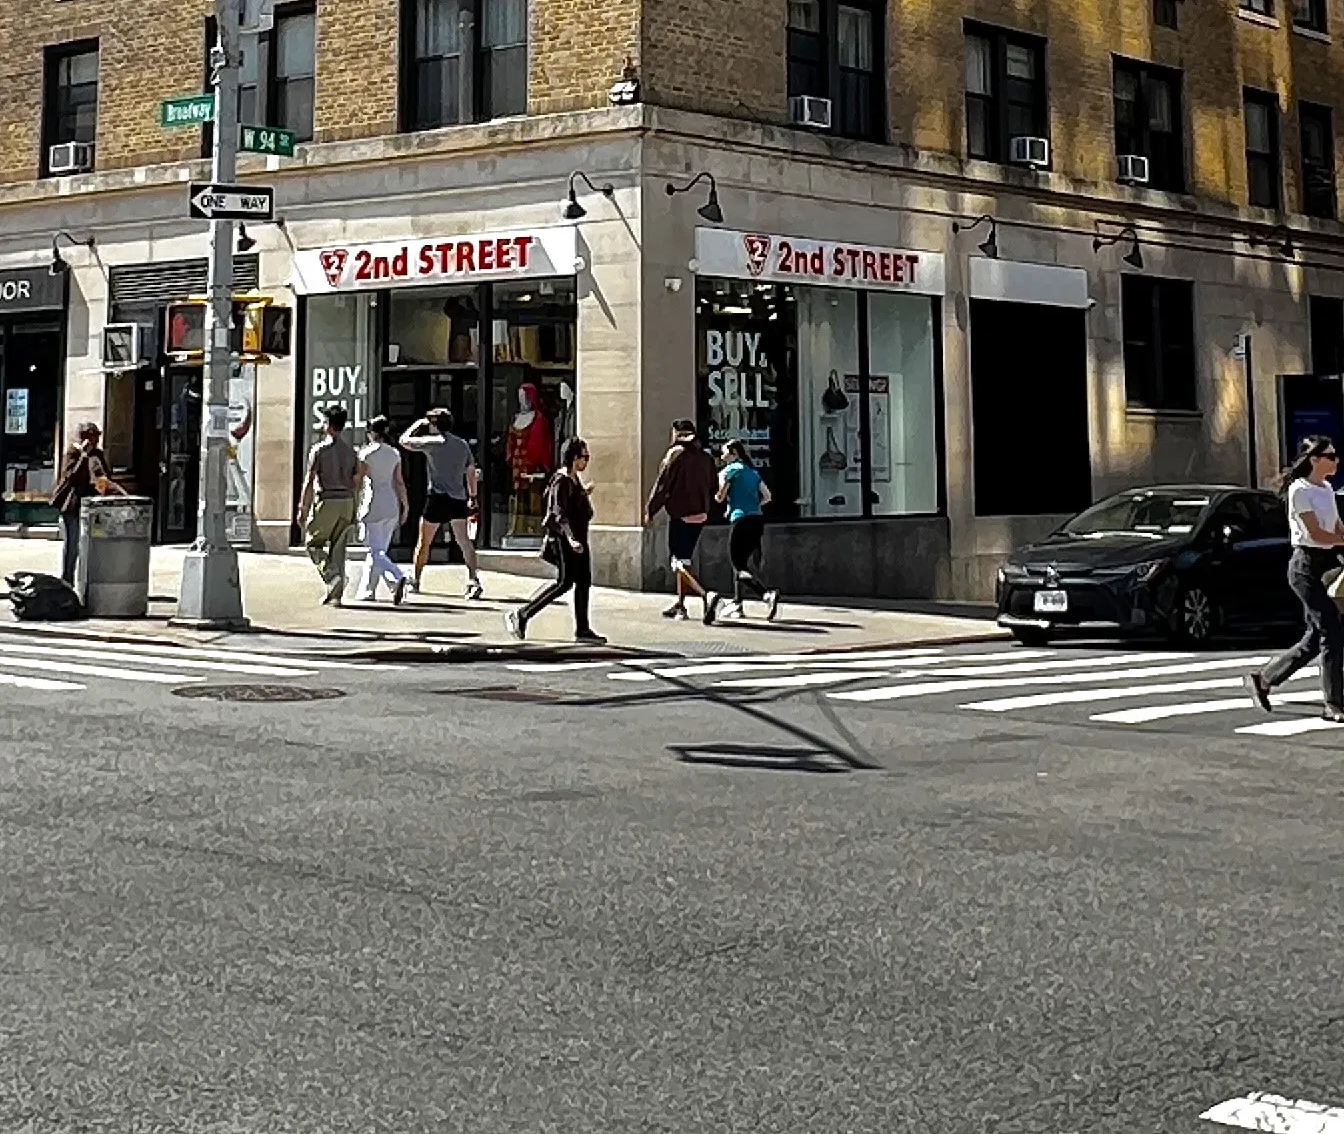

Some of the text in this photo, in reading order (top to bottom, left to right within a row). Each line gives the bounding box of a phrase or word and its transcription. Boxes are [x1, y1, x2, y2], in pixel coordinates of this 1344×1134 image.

[167, 102, 212, 122] Broadway
[244, 128, 256, 149] W
[258, 130, 276, 151] 94
[200, 194, 267, 210] ONE WAY
[355, 246, 408, 281] 2nd
[419, 236, 533, 274] STREET
[778, 241, 825, 276] 2nd
[833, 247, 919, 283] STREET
[707, 330, 761, 367] BUY
[313, 365, 361, 396] BUY
[708, 370, 770, 407] SELL
